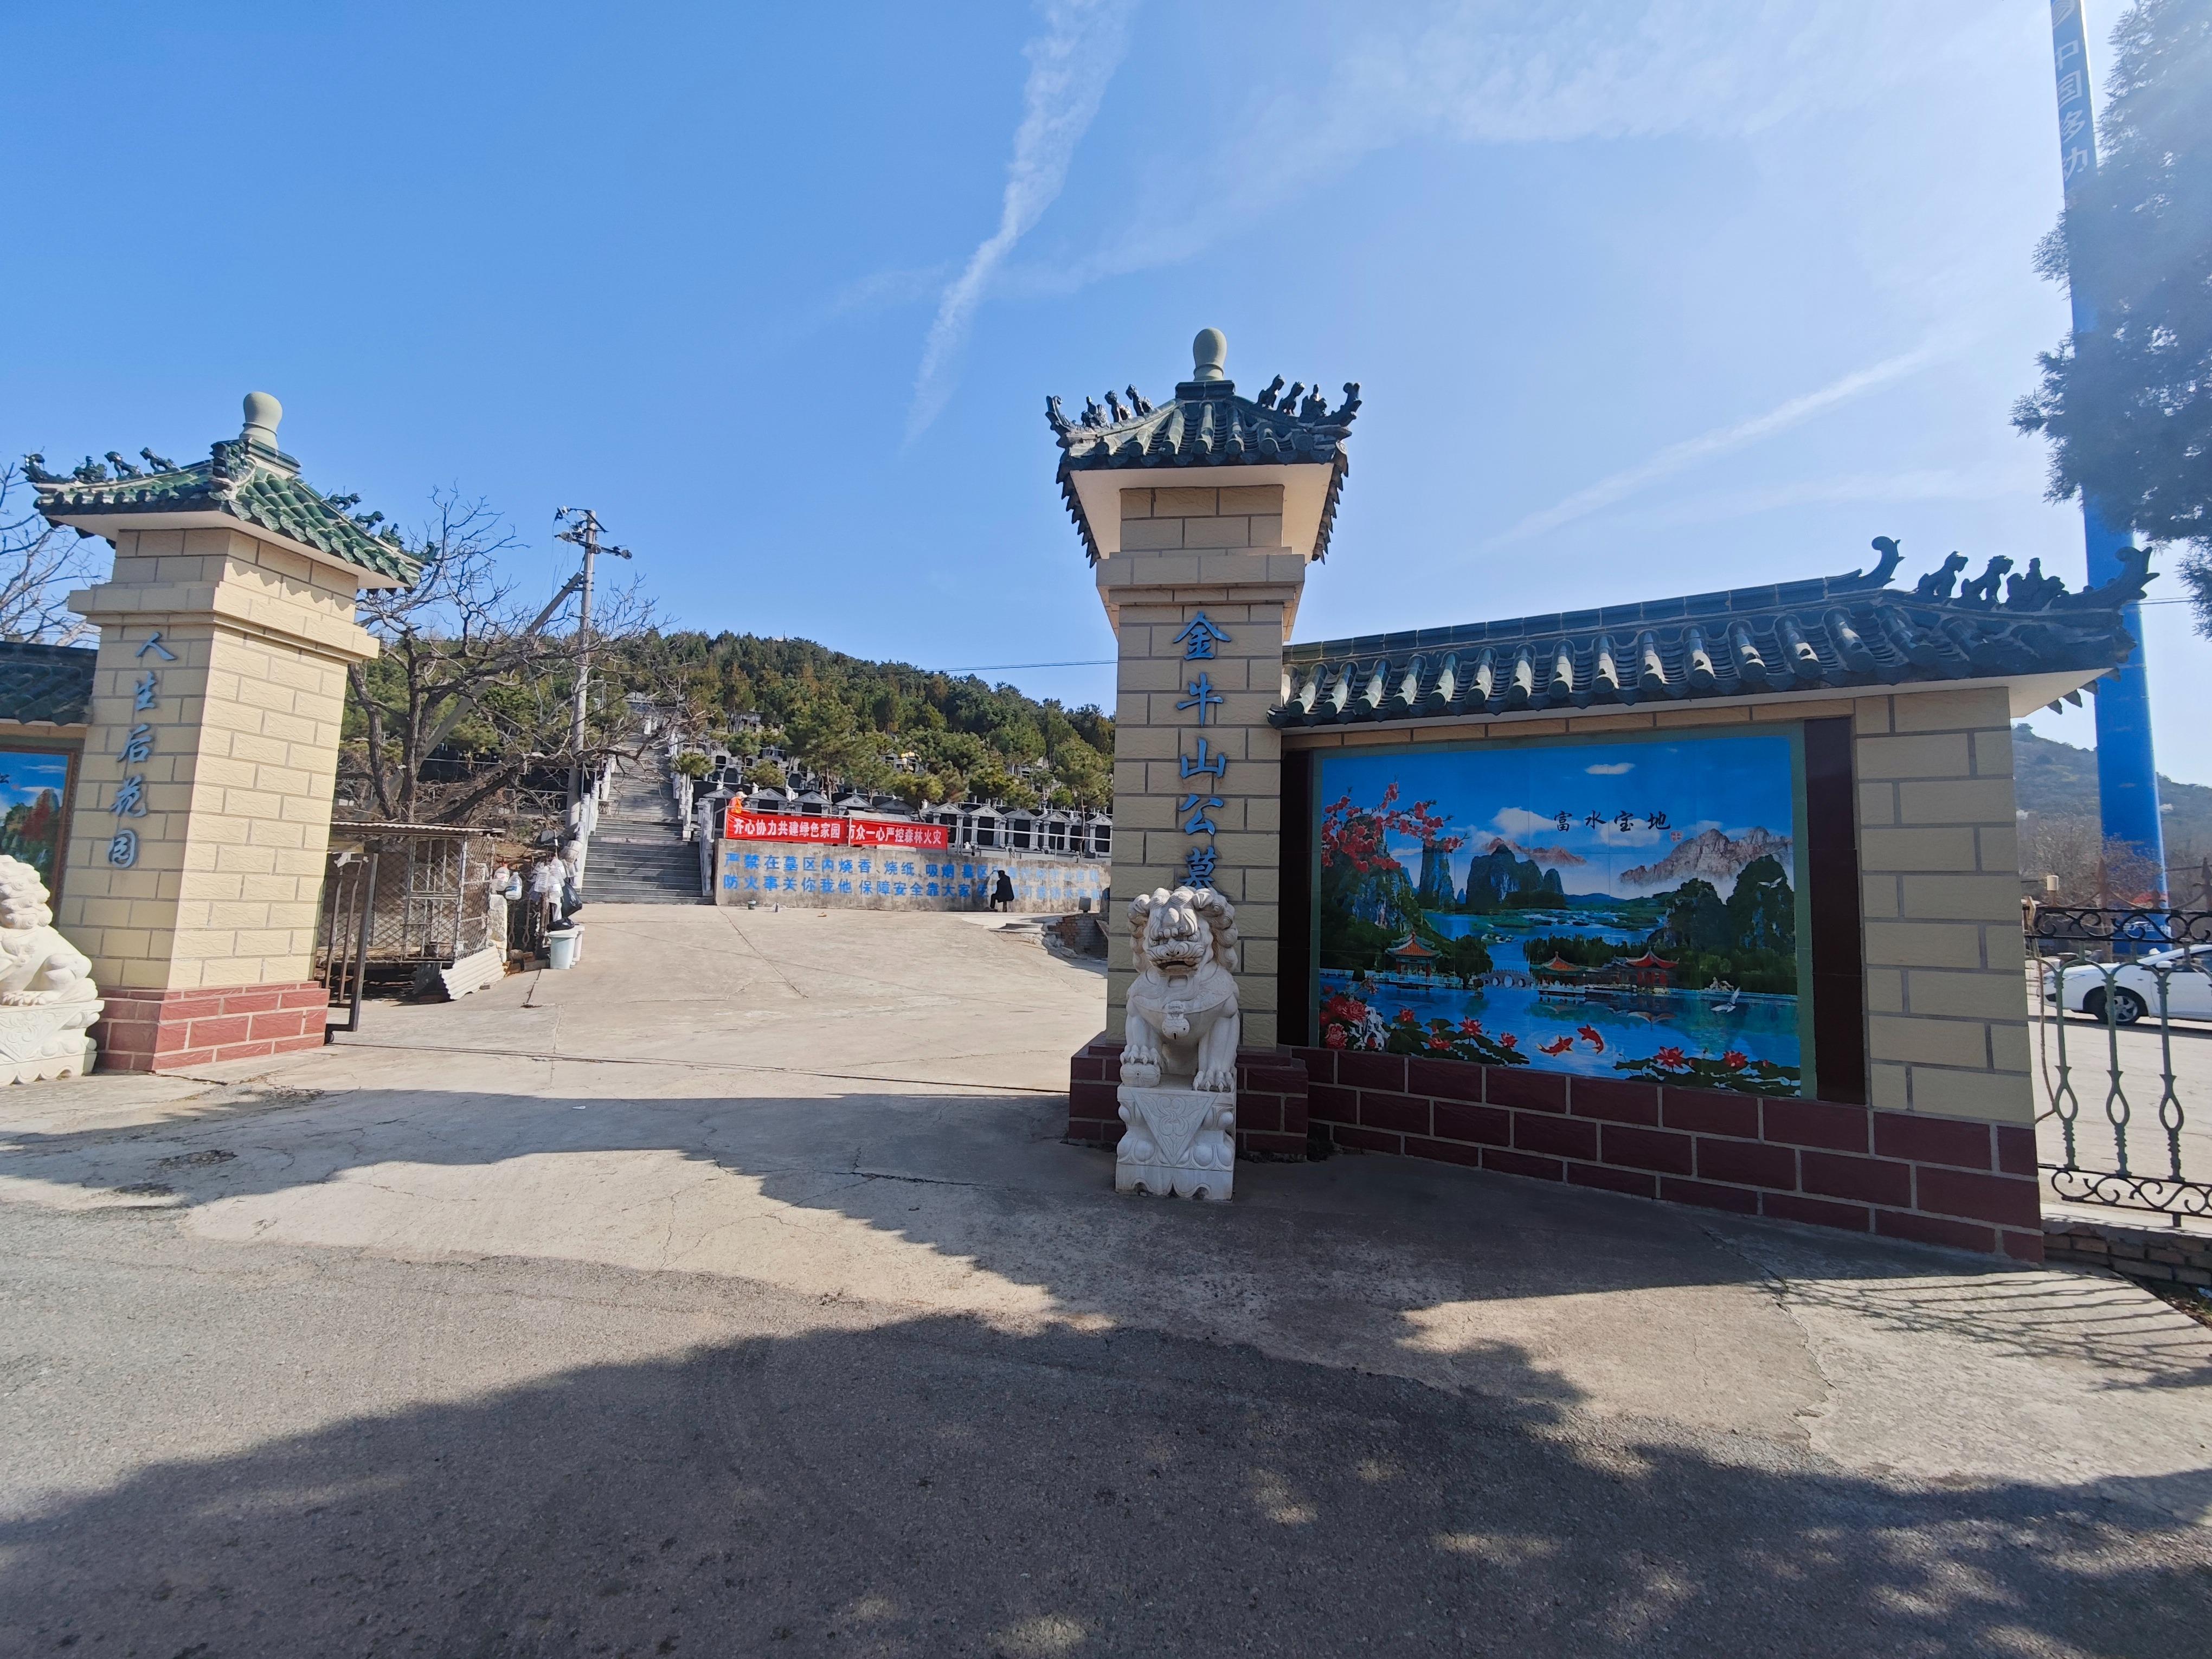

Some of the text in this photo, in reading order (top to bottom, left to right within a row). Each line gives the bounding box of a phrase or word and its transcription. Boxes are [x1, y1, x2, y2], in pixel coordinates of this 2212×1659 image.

[107, 632, 177, 869] 人生后花园
[734, 818, 840, 839] 齐心协力共建绿色家园
[1554, 810, 1671, 832] 富水宝地
